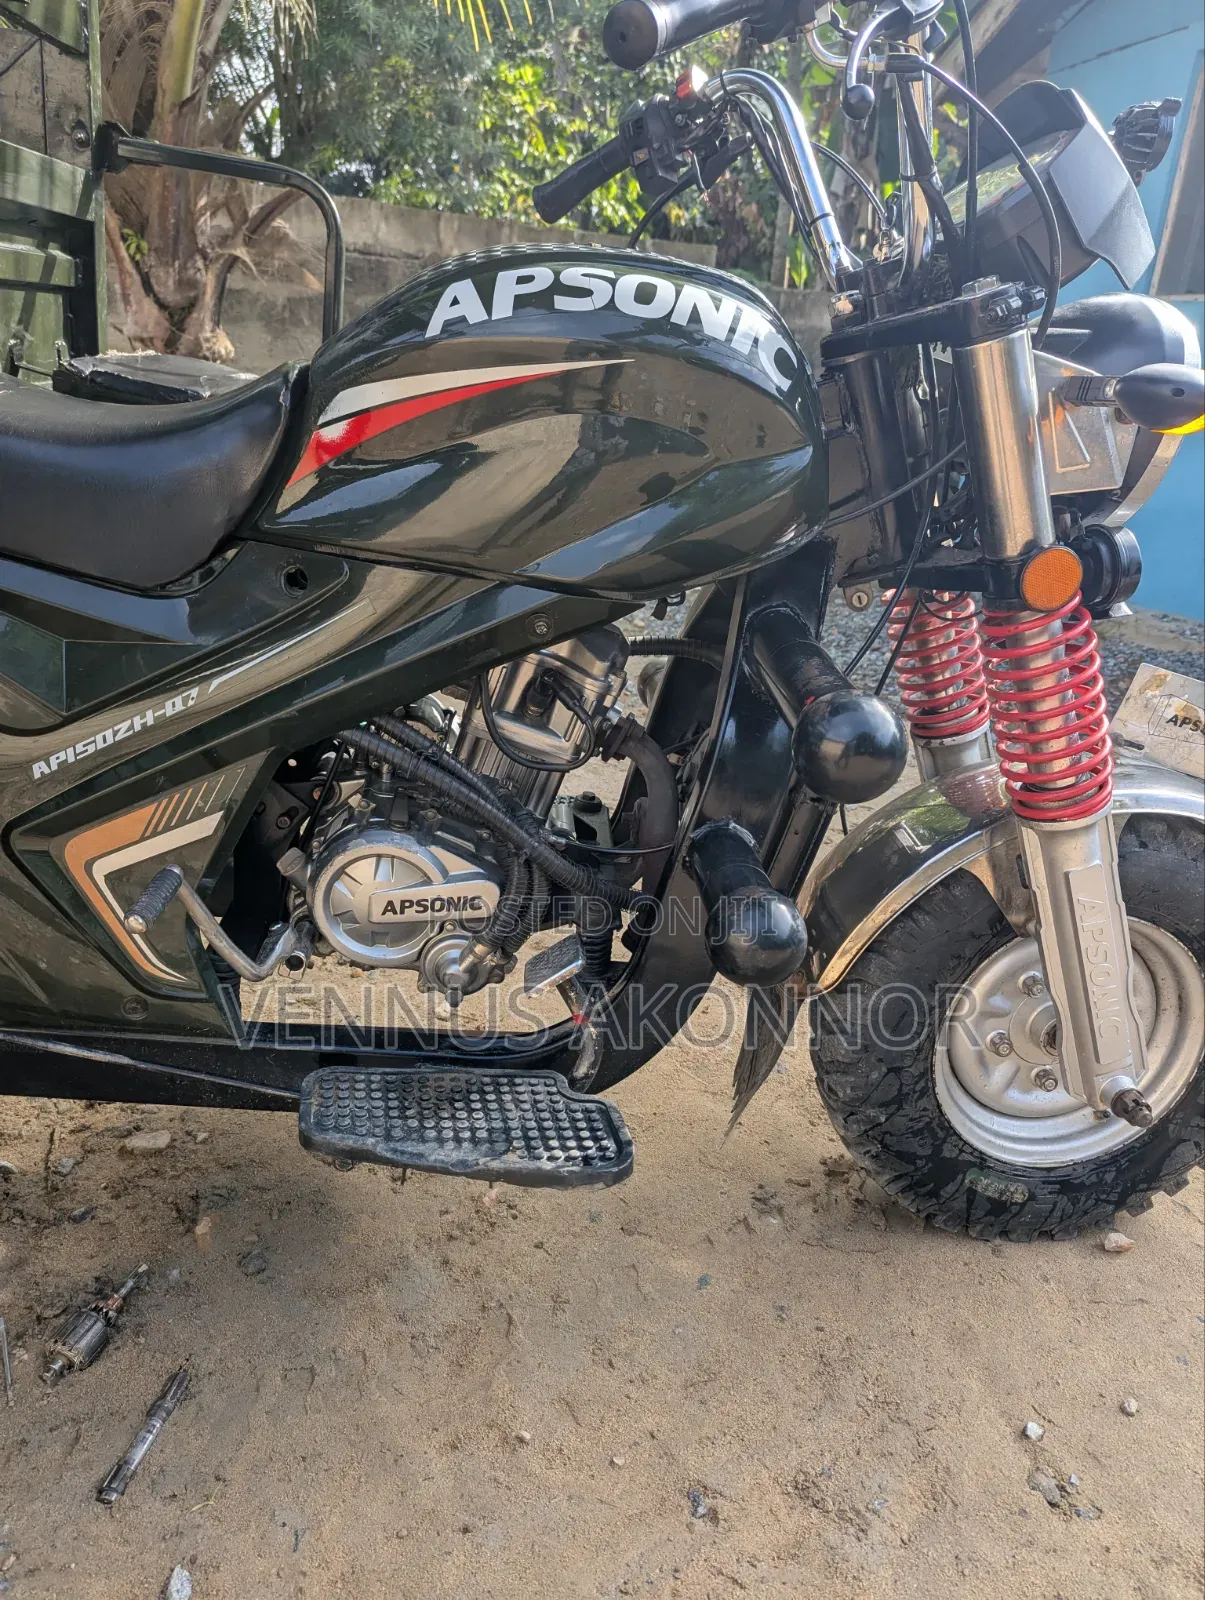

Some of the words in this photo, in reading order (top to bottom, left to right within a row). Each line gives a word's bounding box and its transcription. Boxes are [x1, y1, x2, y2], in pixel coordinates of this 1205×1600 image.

[424, 266, 798, 392] APSONIC
[1165, 713, 1205, 736] APS
[381, 895, 482, 916] APSONIC
[1077, 897, 1123, 1040] APSONIC
